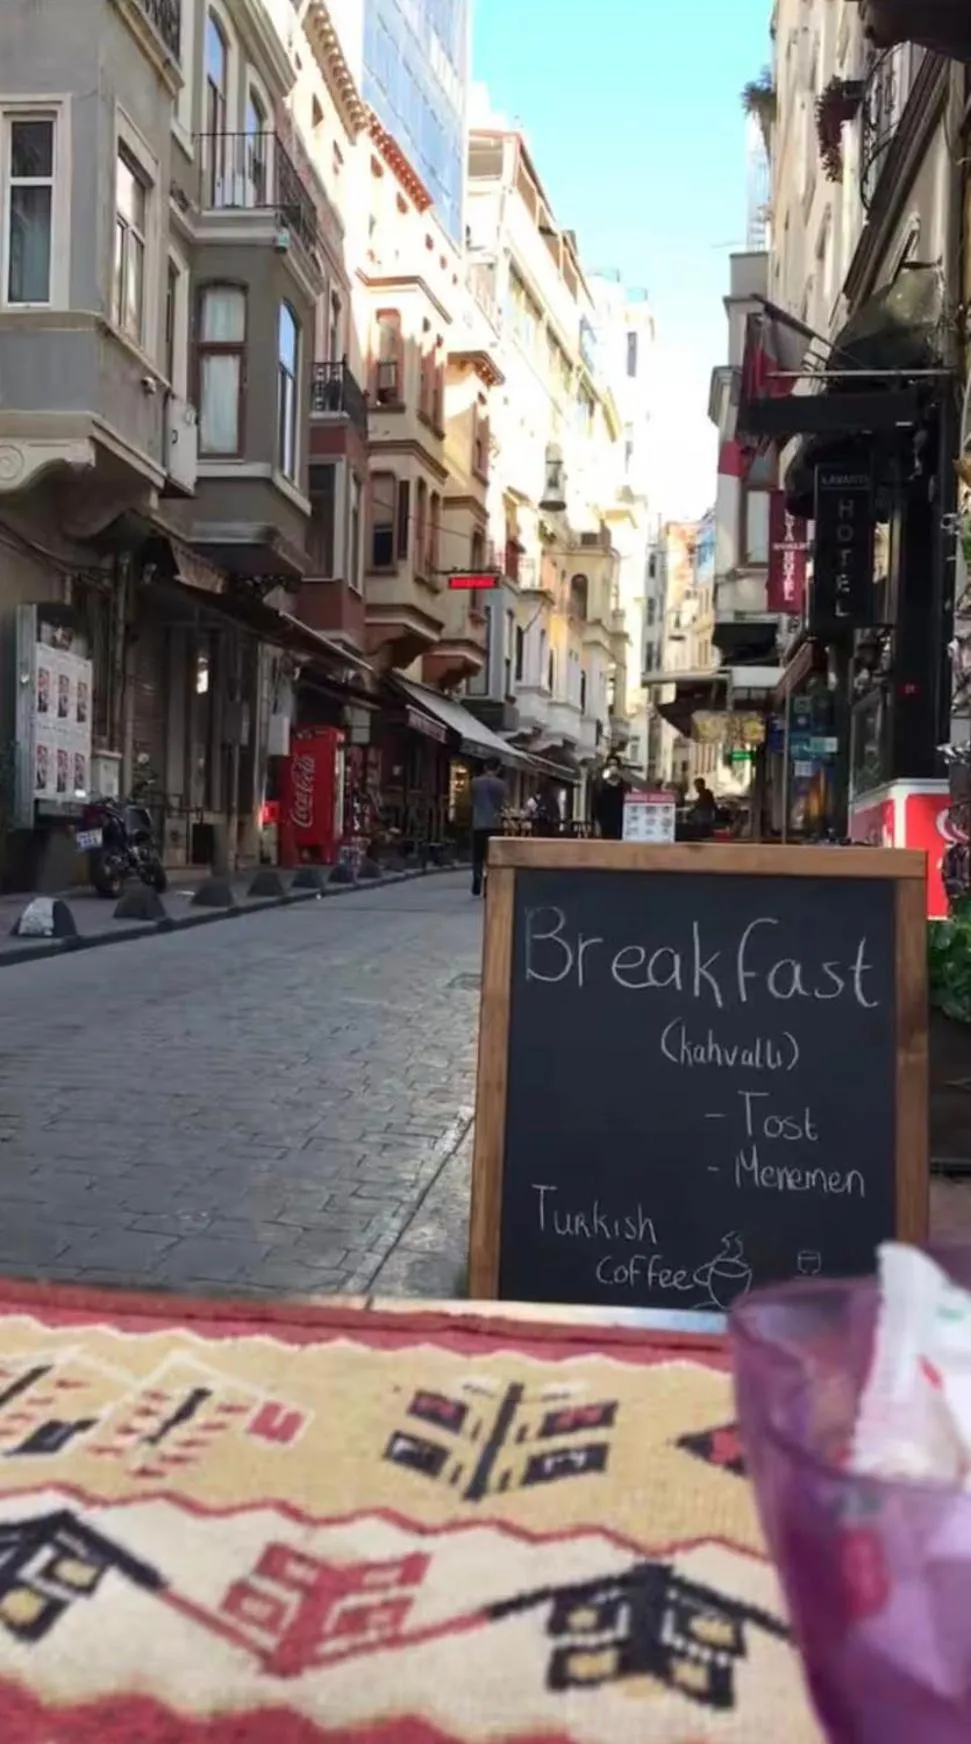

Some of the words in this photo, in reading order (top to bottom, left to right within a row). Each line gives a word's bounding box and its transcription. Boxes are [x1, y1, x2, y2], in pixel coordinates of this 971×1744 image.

[835, 498, 854, 617] HOTEL
[525, 905, 879, 1009] Breakfast
[737, 1089, 819, 1142] Tost
[531, 1183, 658, 1245] Turkish
